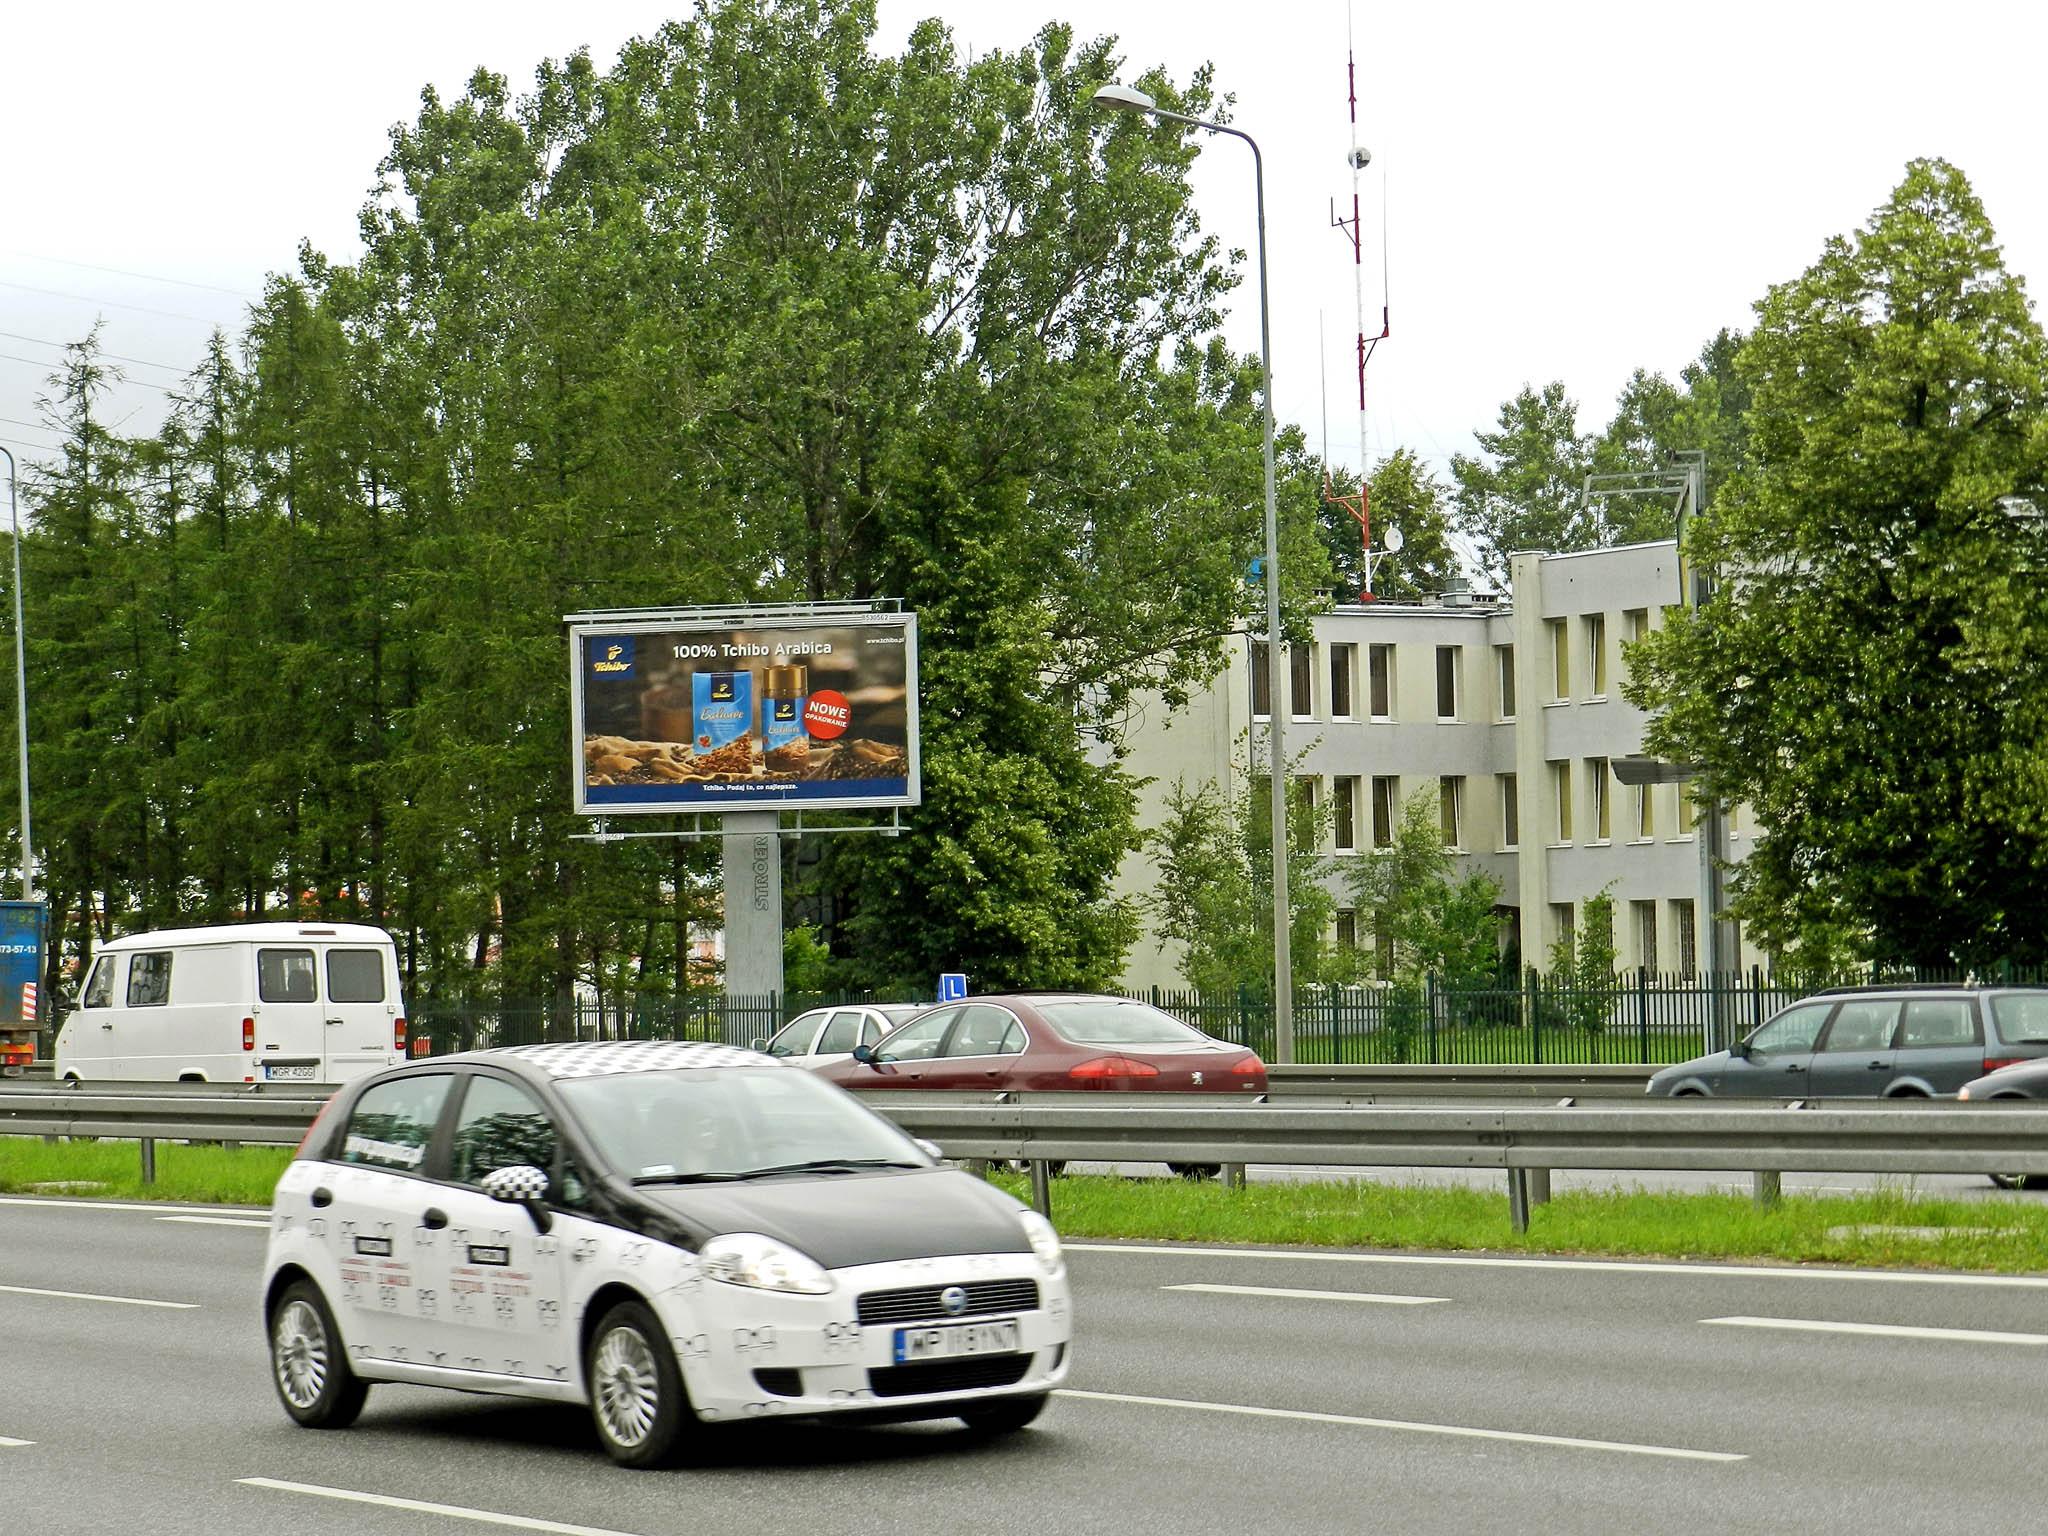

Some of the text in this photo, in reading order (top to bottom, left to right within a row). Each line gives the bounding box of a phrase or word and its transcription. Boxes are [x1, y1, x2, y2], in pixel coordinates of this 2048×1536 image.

[673, 641, 832, 658] 100% Tchibo Arabica
[593, 661, 632, 672] Tchibo
[809, 701, 847, 719] NOWE
[805, 712, 847, 728] OPAKOWANIE
[727, 784, 745, 792] Podaj
[0, 944, 37, 953] 73-57-13
[950, 979, 962, 998] L
[272, 1067, 290, 1077] WGR
